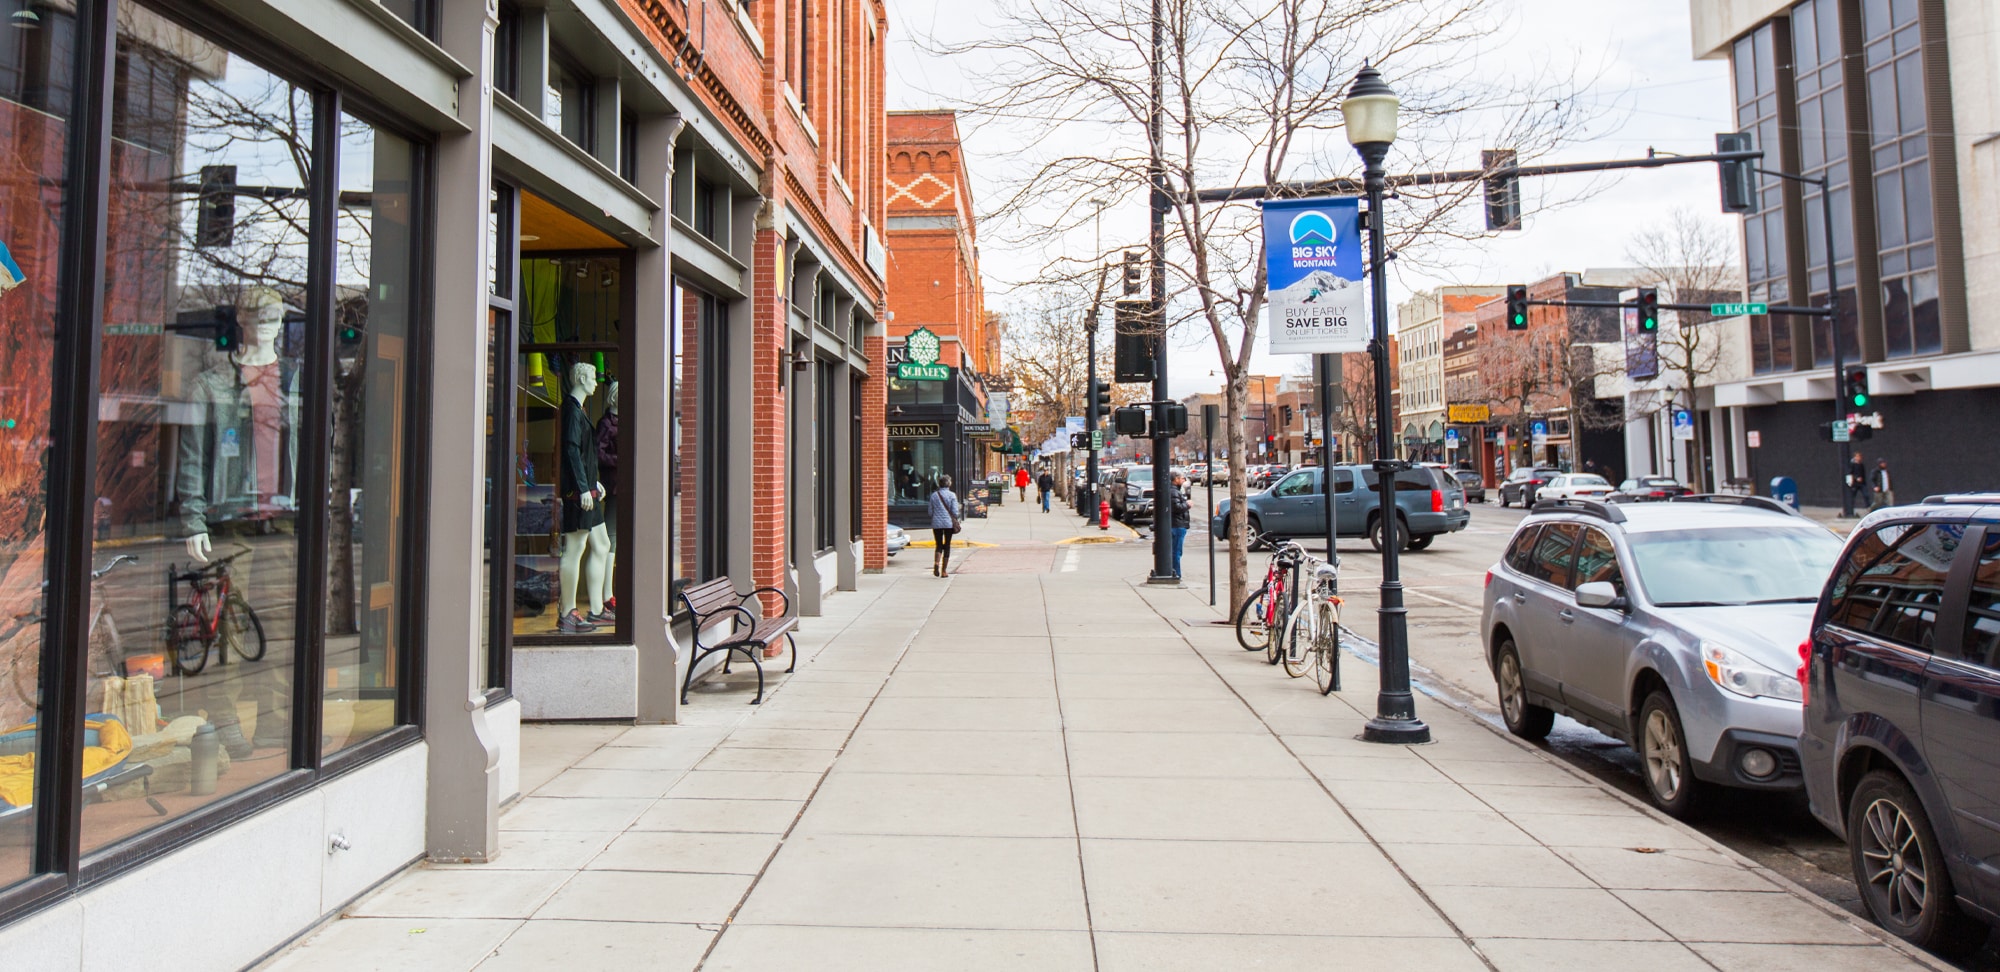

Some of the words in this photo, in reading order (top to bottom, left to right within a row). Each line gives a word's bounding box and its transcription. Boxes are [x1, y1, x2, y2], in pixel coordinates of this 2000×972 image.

[1292, 247, 1313, 258] BIG
[1315, 246, 1337, 257] SKY
[1294, 260, 1337, 268] MONTANA
[1285, 308, 1309, 317] BUY
[1313, 306, 1347, 316] EARLY
[1725, 304, 1747, 314] BLACK
[1286, 318, 1320, 328] SAVE
[1325, 316, 1347, 327] BIG
[901, 365, 948, 378] SCHNEE'S
